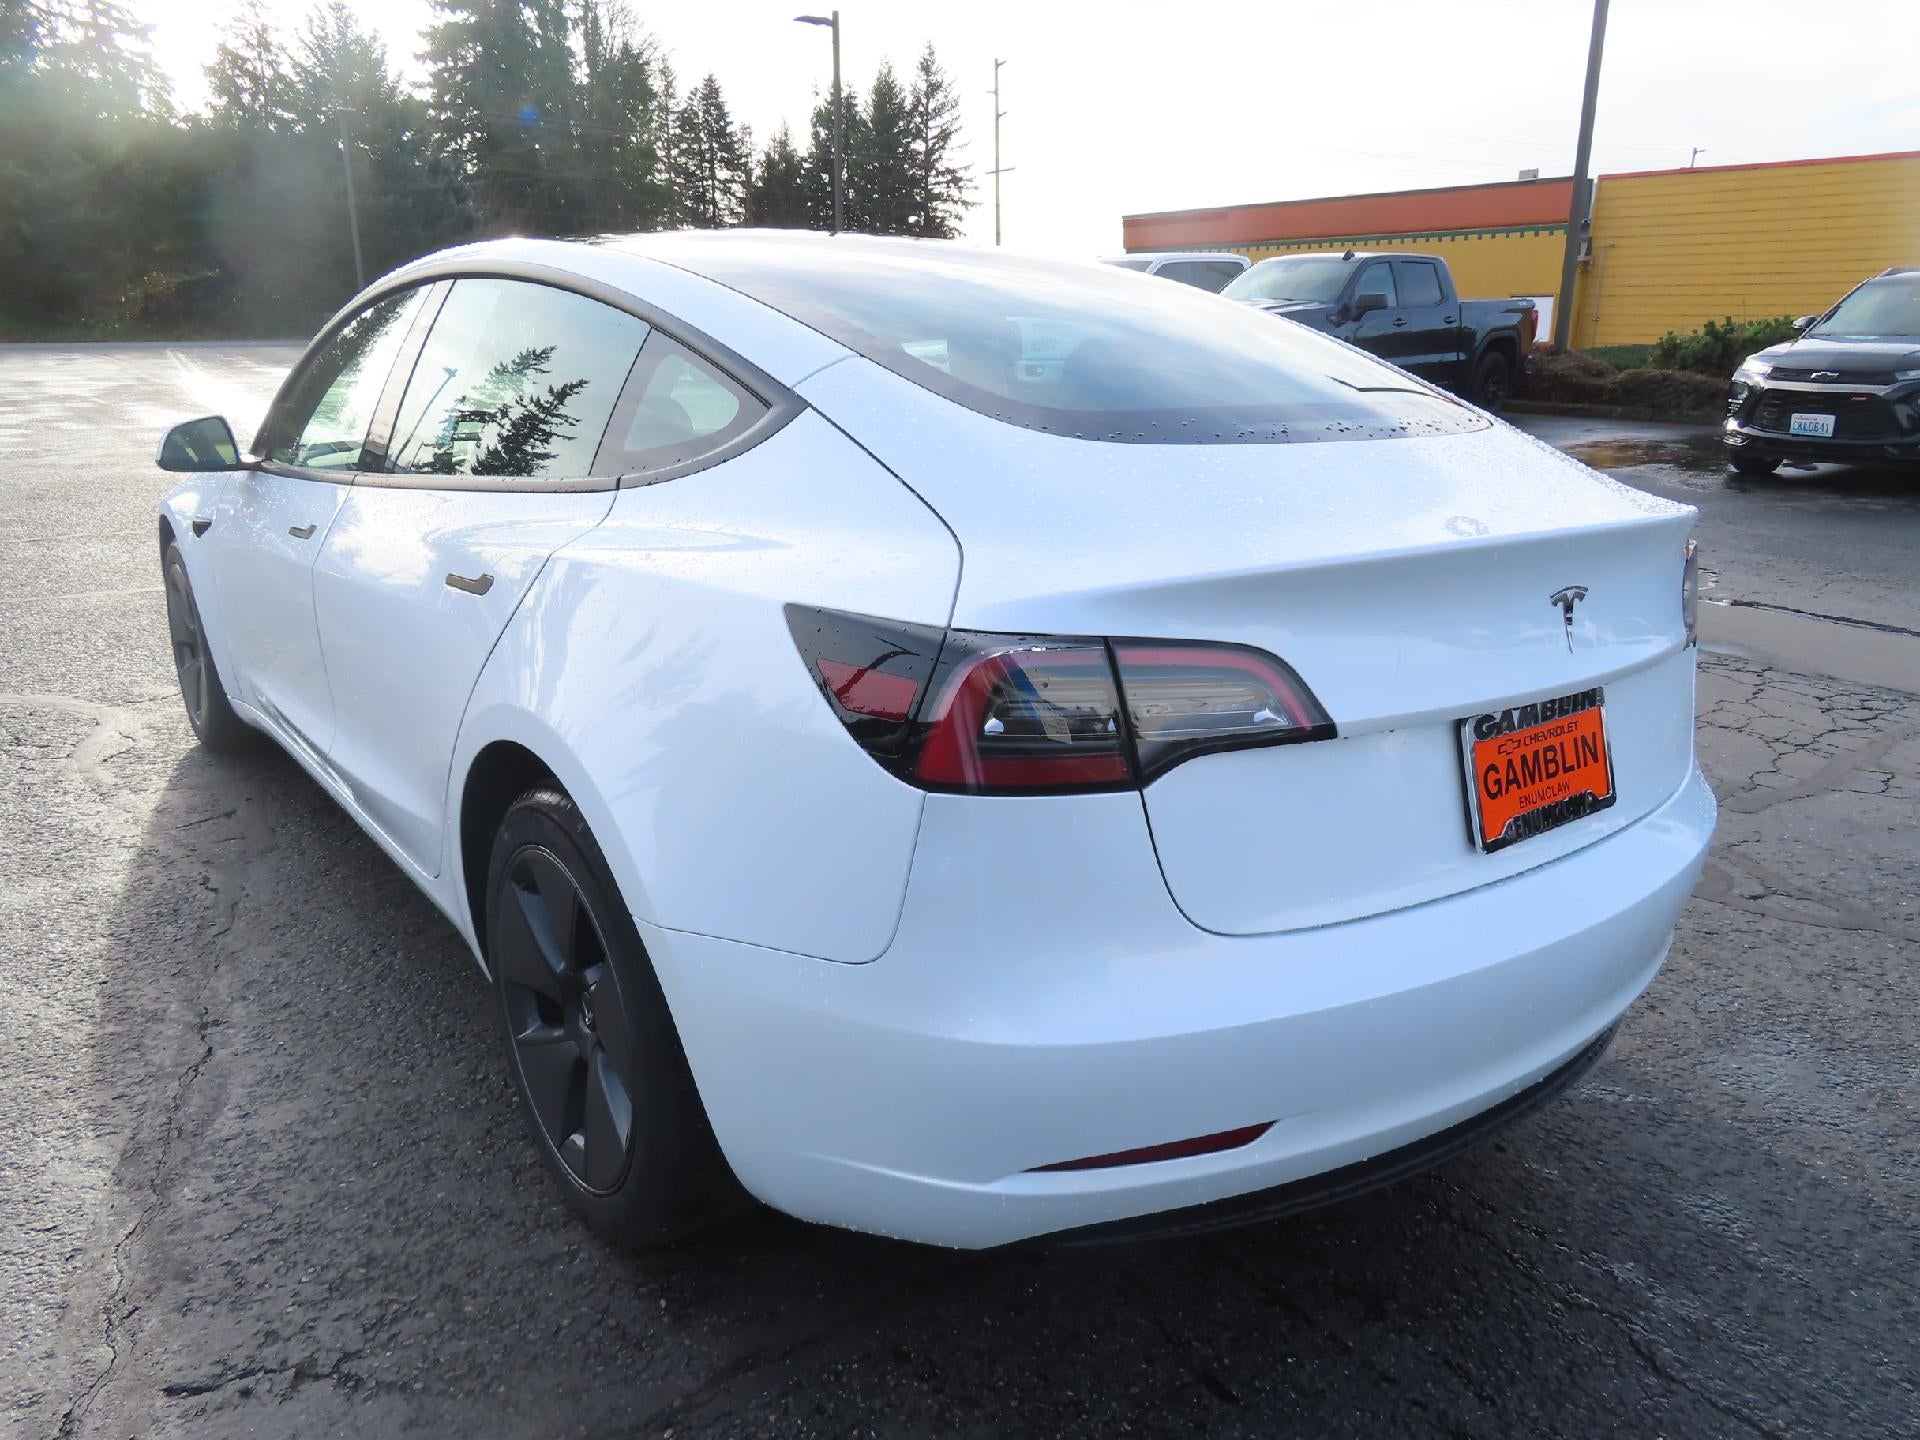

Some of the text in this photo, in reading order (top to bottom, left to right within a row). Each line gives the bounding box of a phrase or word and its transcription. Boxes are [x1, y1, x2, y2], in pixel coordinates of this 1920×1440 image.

[1523, 721, 1579, 746] CHEVROLET
[1483, 731, 1599, 800] GAMBLIN
[1519, 779, 1570, 809] ENUMCLAW
